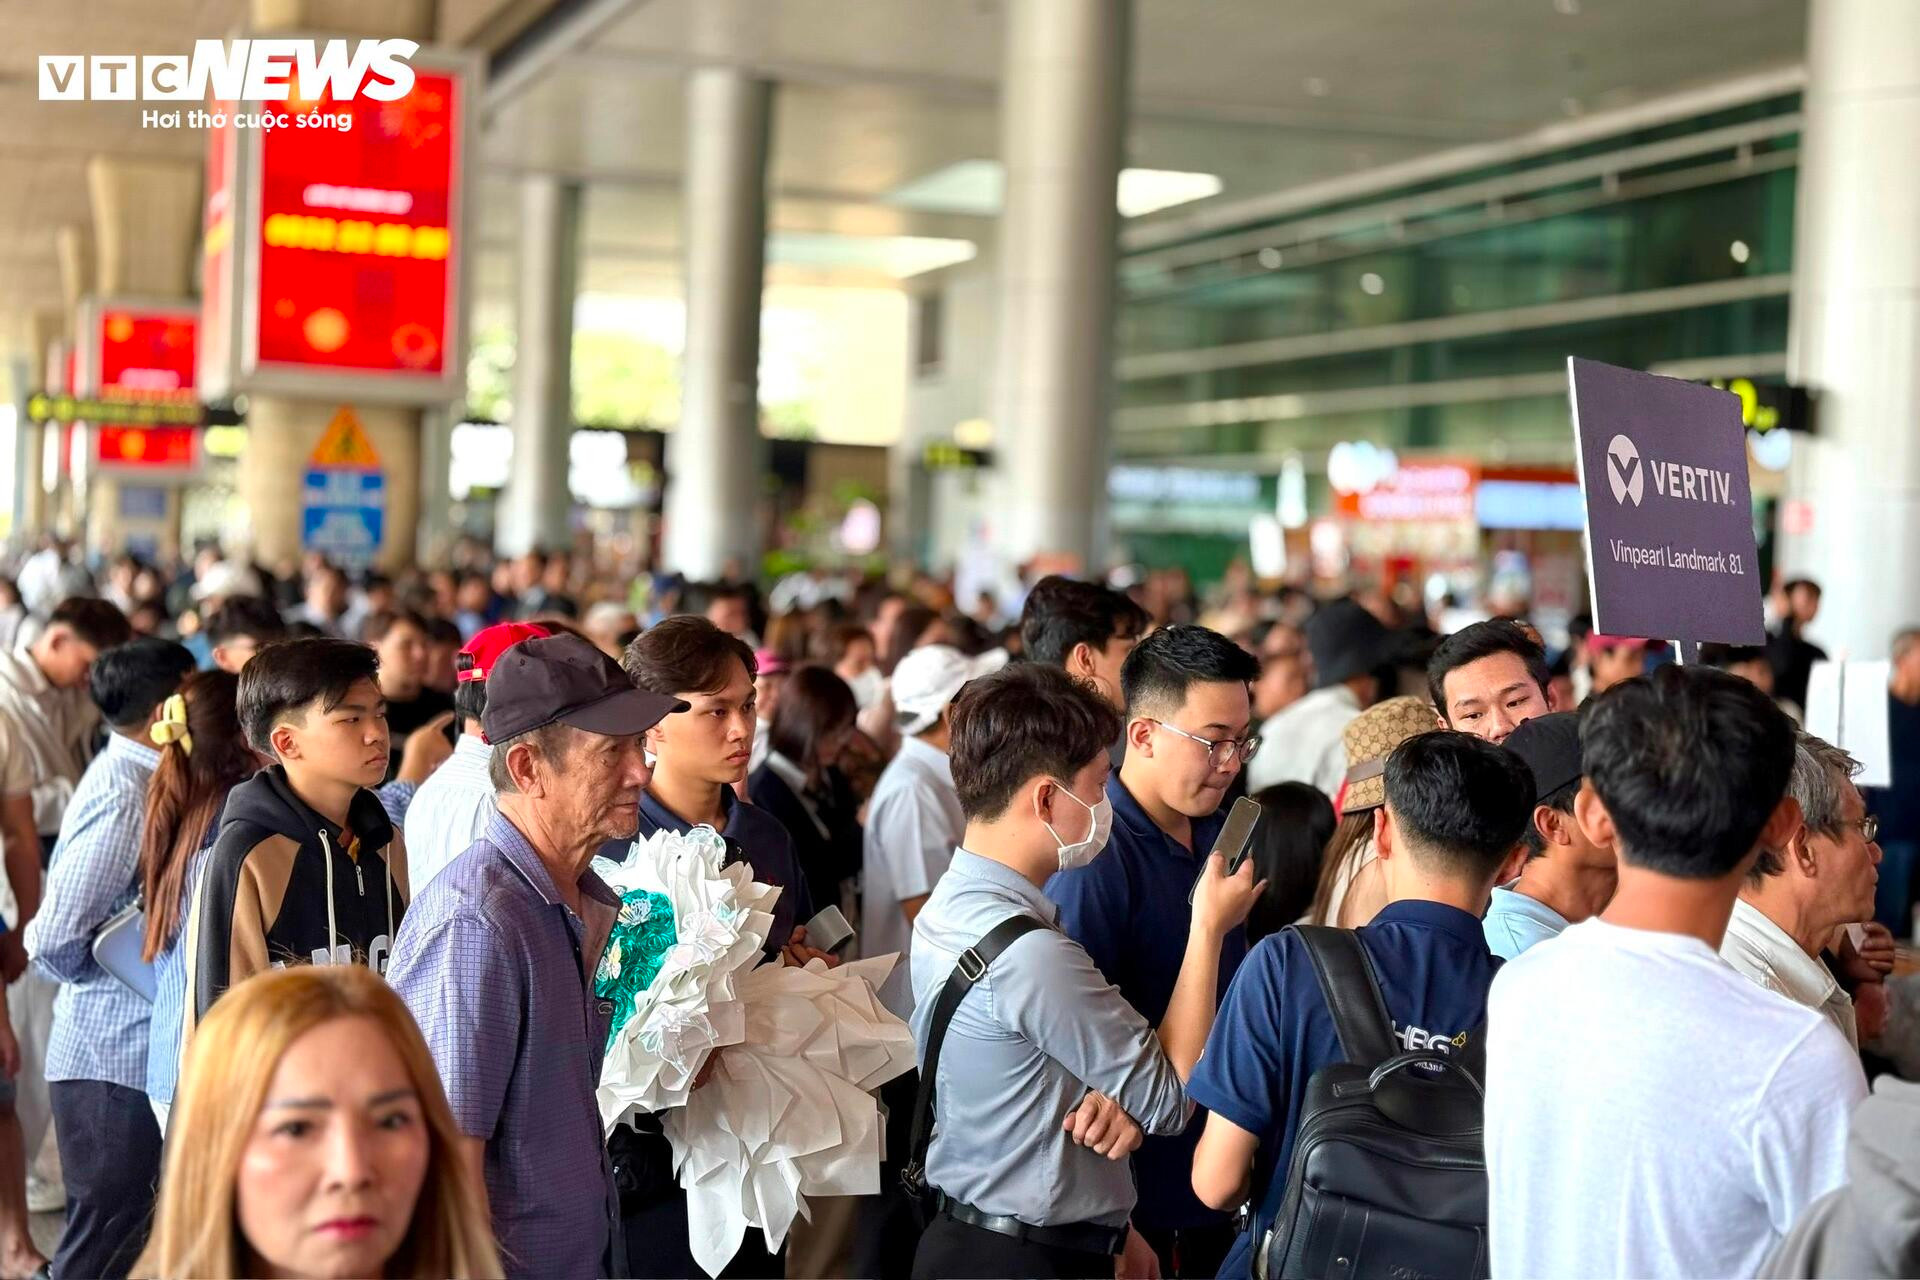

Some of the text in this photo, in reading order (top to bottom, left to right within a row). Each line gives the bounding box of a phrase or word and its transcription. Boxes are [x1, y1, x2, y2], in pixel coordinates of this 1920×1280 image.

[1650, 460, 1730, 505] VERTIV
[1610, 539, 1744, 574] Vinpearl Landmark 81
